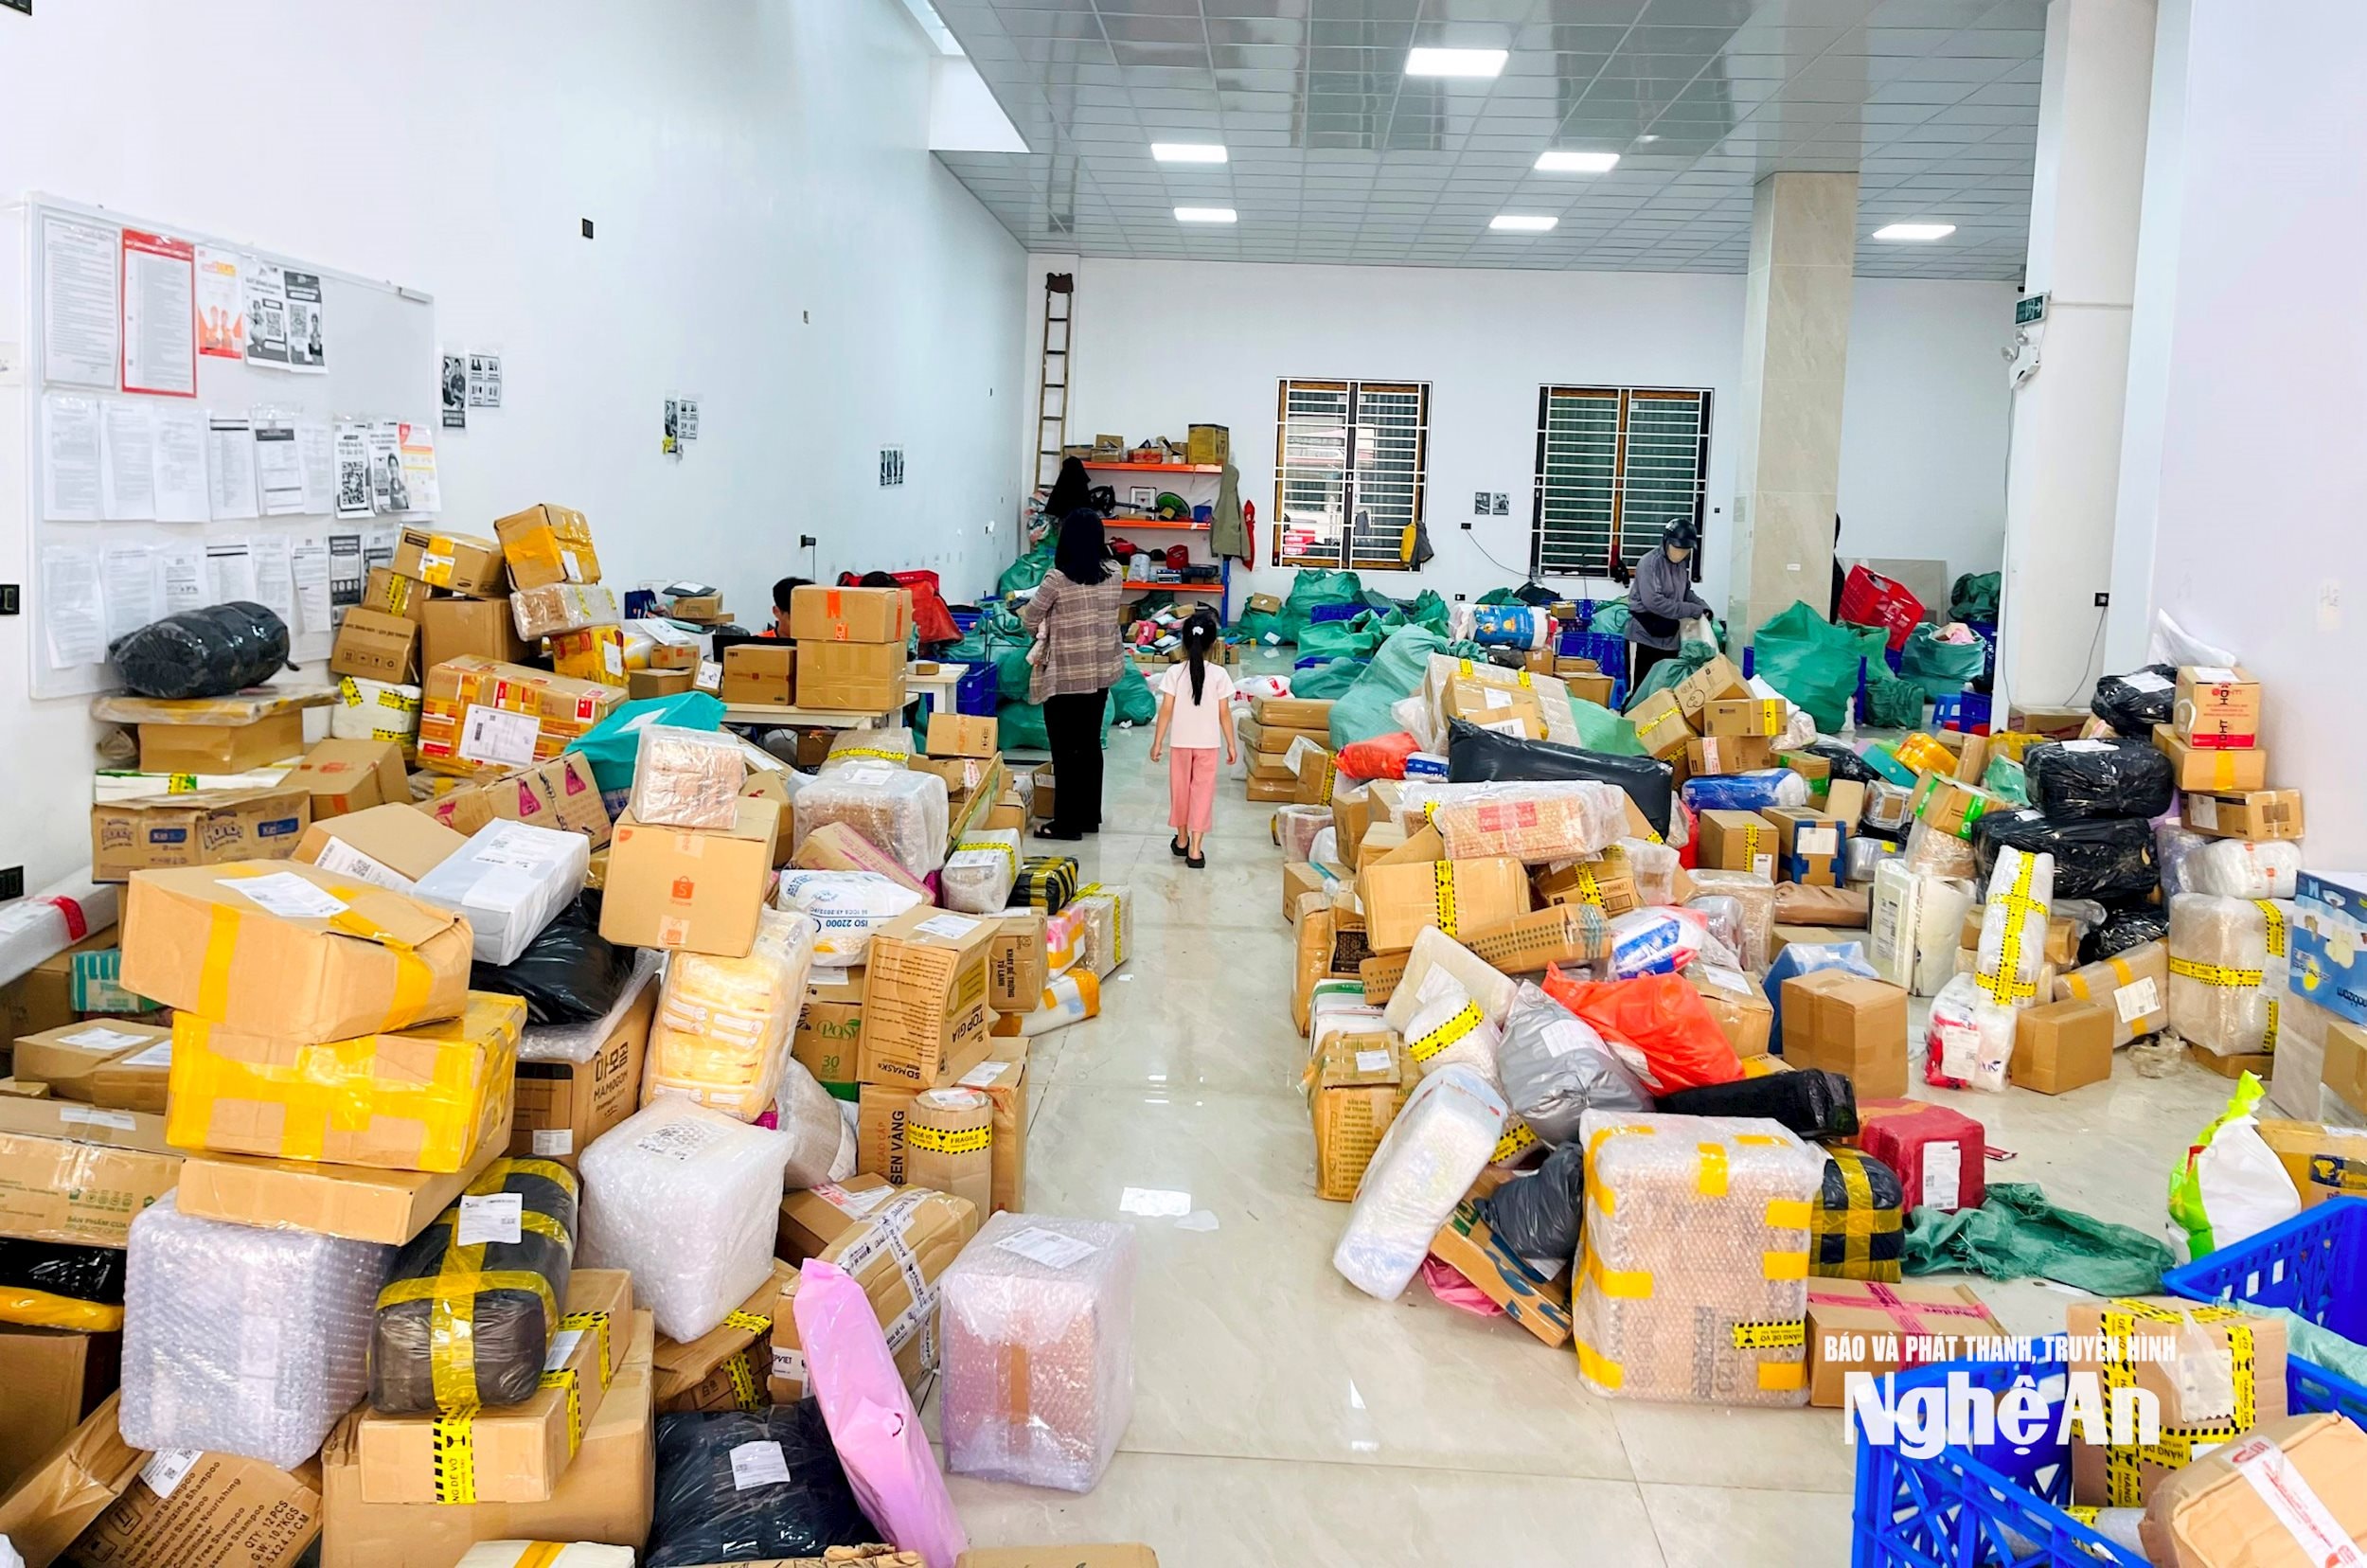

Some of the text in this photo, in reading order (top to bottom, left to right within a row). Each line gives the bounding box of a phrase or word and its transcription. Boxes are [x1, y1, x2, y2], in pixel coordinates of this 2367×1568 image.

[826, 919, 868, 928] ISO 22000
[823, 1055, 840, 1068] 30
[887, 1111, 904, 1185] SEN VÀNG
[950, 1134, 979, 1145] FRAGILE
[144, 1500, 190, 1547] Moisturizing
[186, 1461, 221, 1501] Shampoo
[161, 1471, 196, 1511] Shampoo
[200, 1477, 241, 1523] Nourishing
[174, 1495, 209, 1534] Shampoo
[230, 1504, 265, 1541] Shampoo
[194, 1506, 245, 1563] Free Shampoo
[244, 1529, 265, 1549] QTY:
